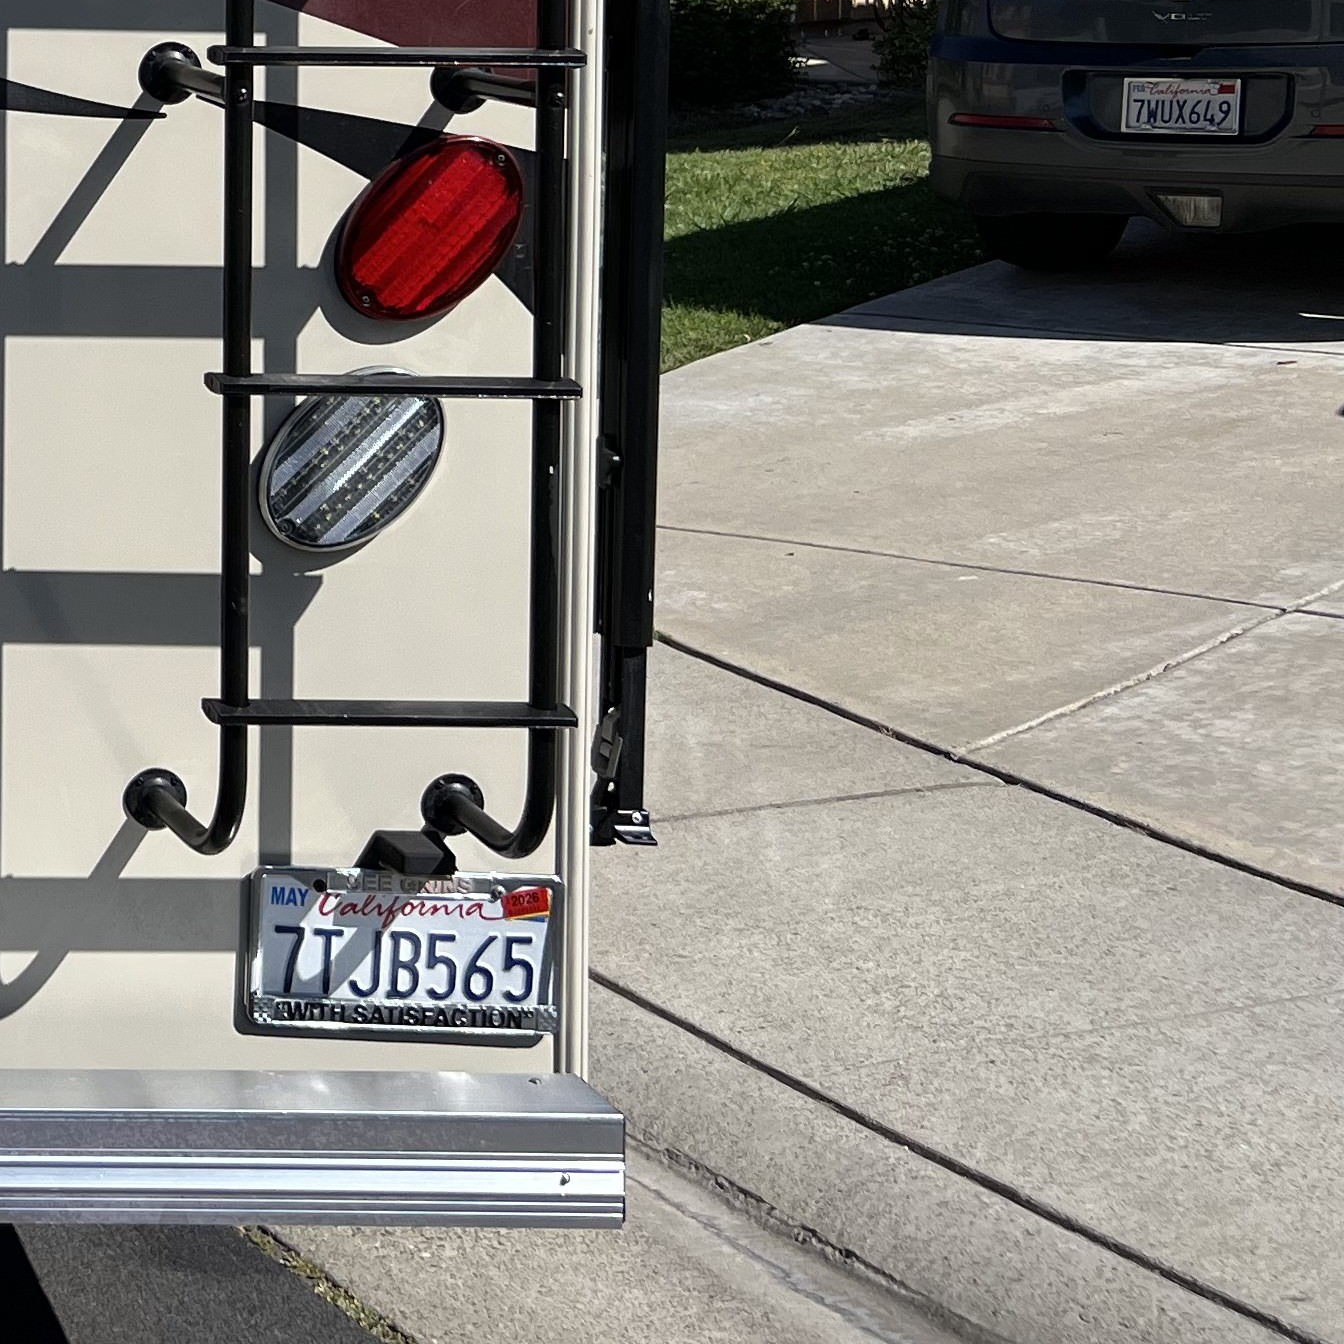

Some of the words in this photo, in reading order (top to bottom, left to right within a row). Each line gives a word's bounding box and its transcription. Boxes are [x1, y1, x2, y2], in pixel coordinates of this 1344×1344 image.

[1151, 10, 1213, 23] VOLT
[1149, 81, 1213, 99] California
[1132, 99, 1232, 126] 7WUX649
[270, 886, 310, 907] MAY
[511, 891, 540, 907] 2026
[318, 890, 506, 928] California
[274, 925, 534, 1003] 7TJB565
